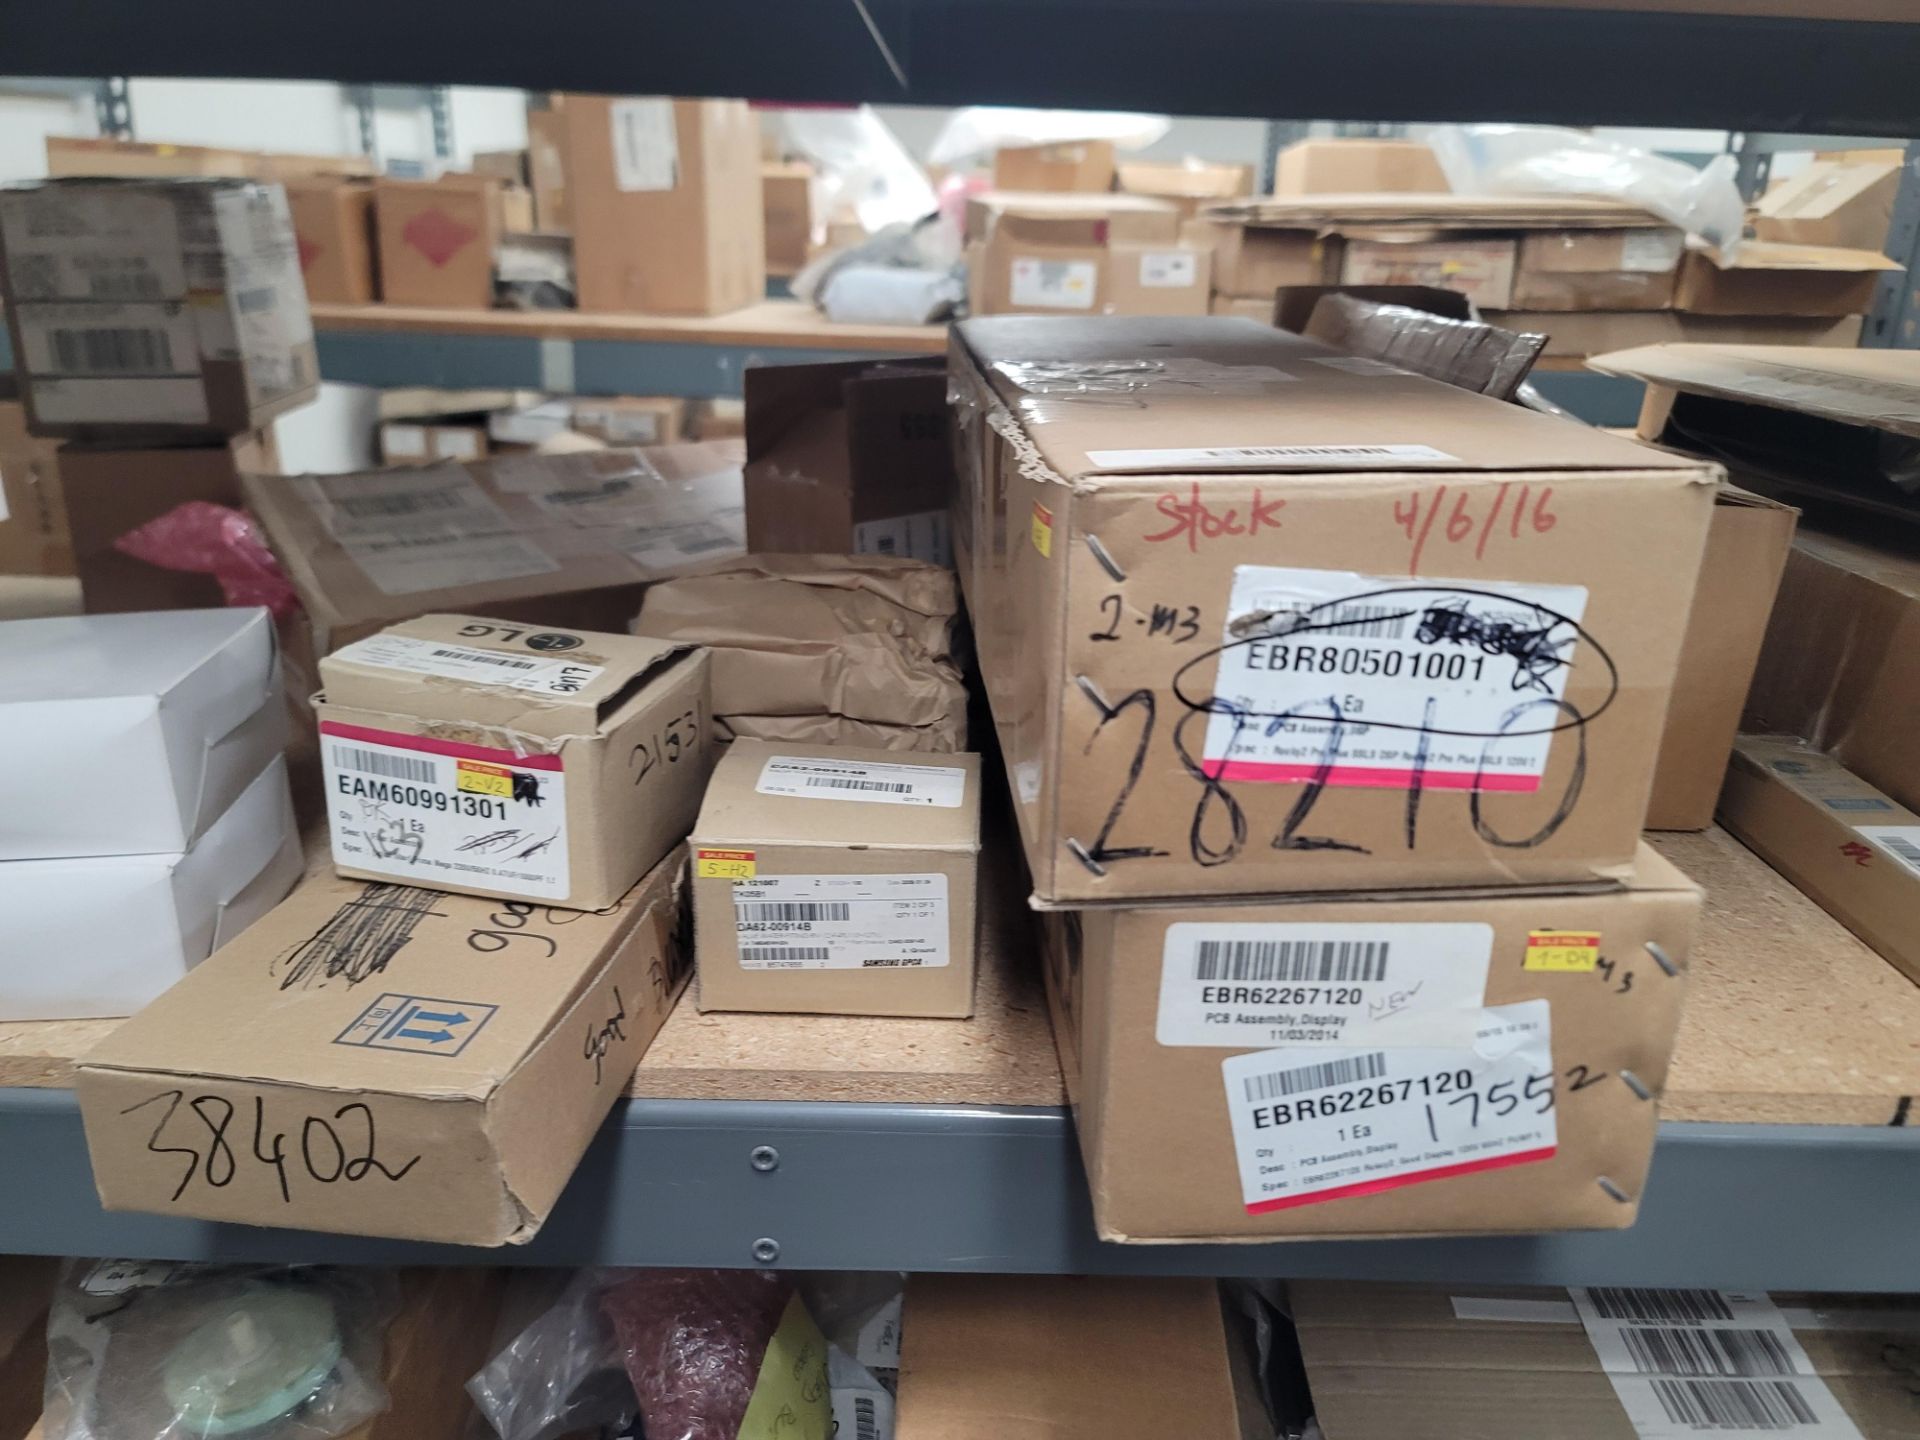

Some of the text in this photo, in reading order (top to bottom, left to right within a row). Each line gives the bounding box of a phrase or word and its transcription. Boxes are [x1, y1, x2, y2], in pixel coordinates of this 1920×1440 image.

[1143, 482, 1558, 578] Stock 4/6/16
[457, 625, 526, 642] LG
[1246, 642, 1486, 681] EBR80501001
[1343, 694, 1364, 713] Ea
[338, 774, 507, 821] EAM60991301
[410, 819, 426, 833] Ea
[1202, 986, 1363, 1005] EBR62267120
[1205, 1012, 1231, 1024] PCB
[1269, 1028, 1340, 1041] 11/03/2014
[1251, 1069, 1474, 1131] EBR62267120
[1337, 1128, 1346, 1142] 1
[1351, 1124, 1372, 1139] Ea
[120, 1089, 423, 1203] 38402
